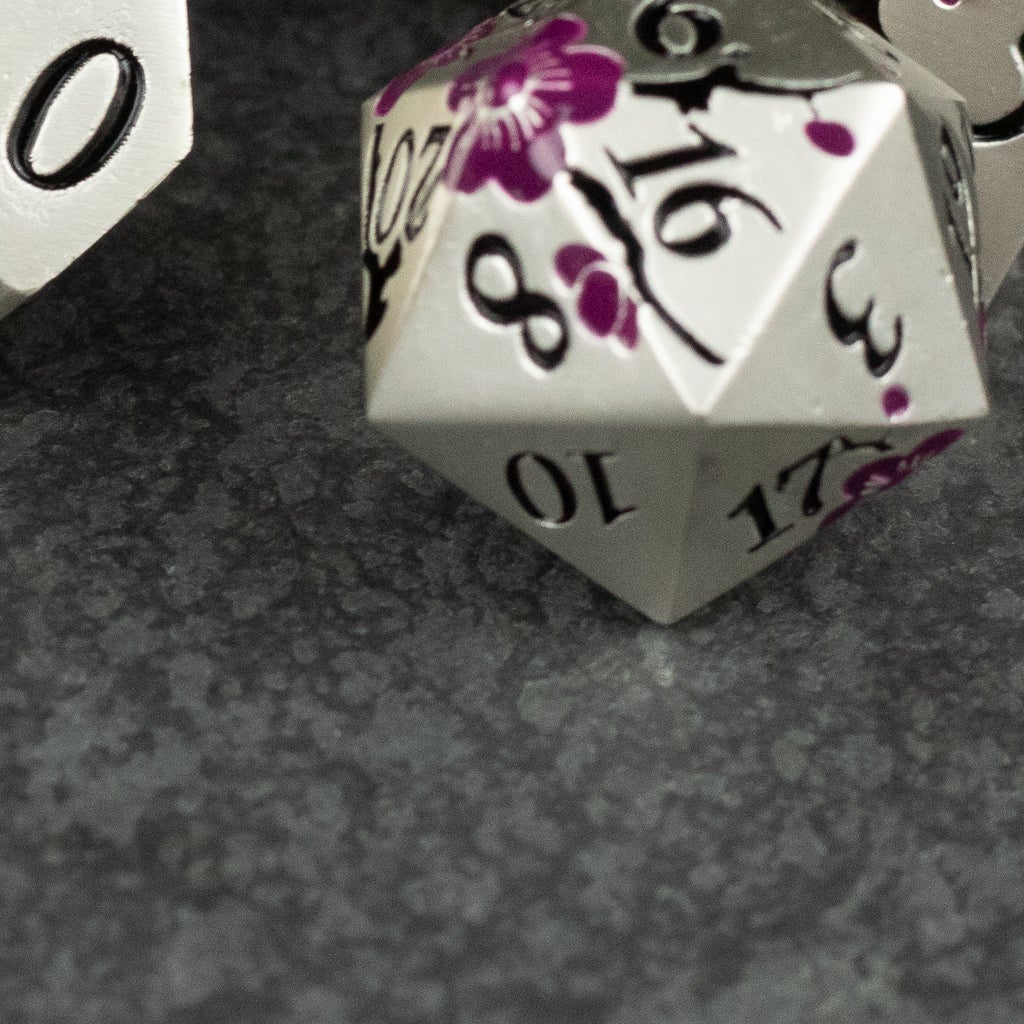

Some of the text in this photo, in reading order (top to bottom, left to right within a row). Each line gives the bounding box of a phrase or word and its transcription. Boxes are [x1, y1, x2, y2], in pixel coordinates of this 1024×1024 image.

[7, 37, 145, 191] 0
[605, 124, 783, 256] 16
[464, 233, 570, 371] 8
[826, 239, 902, 378] 3
[505, 451, 638, 527] 10
[728, 440, 832, 554] 17
